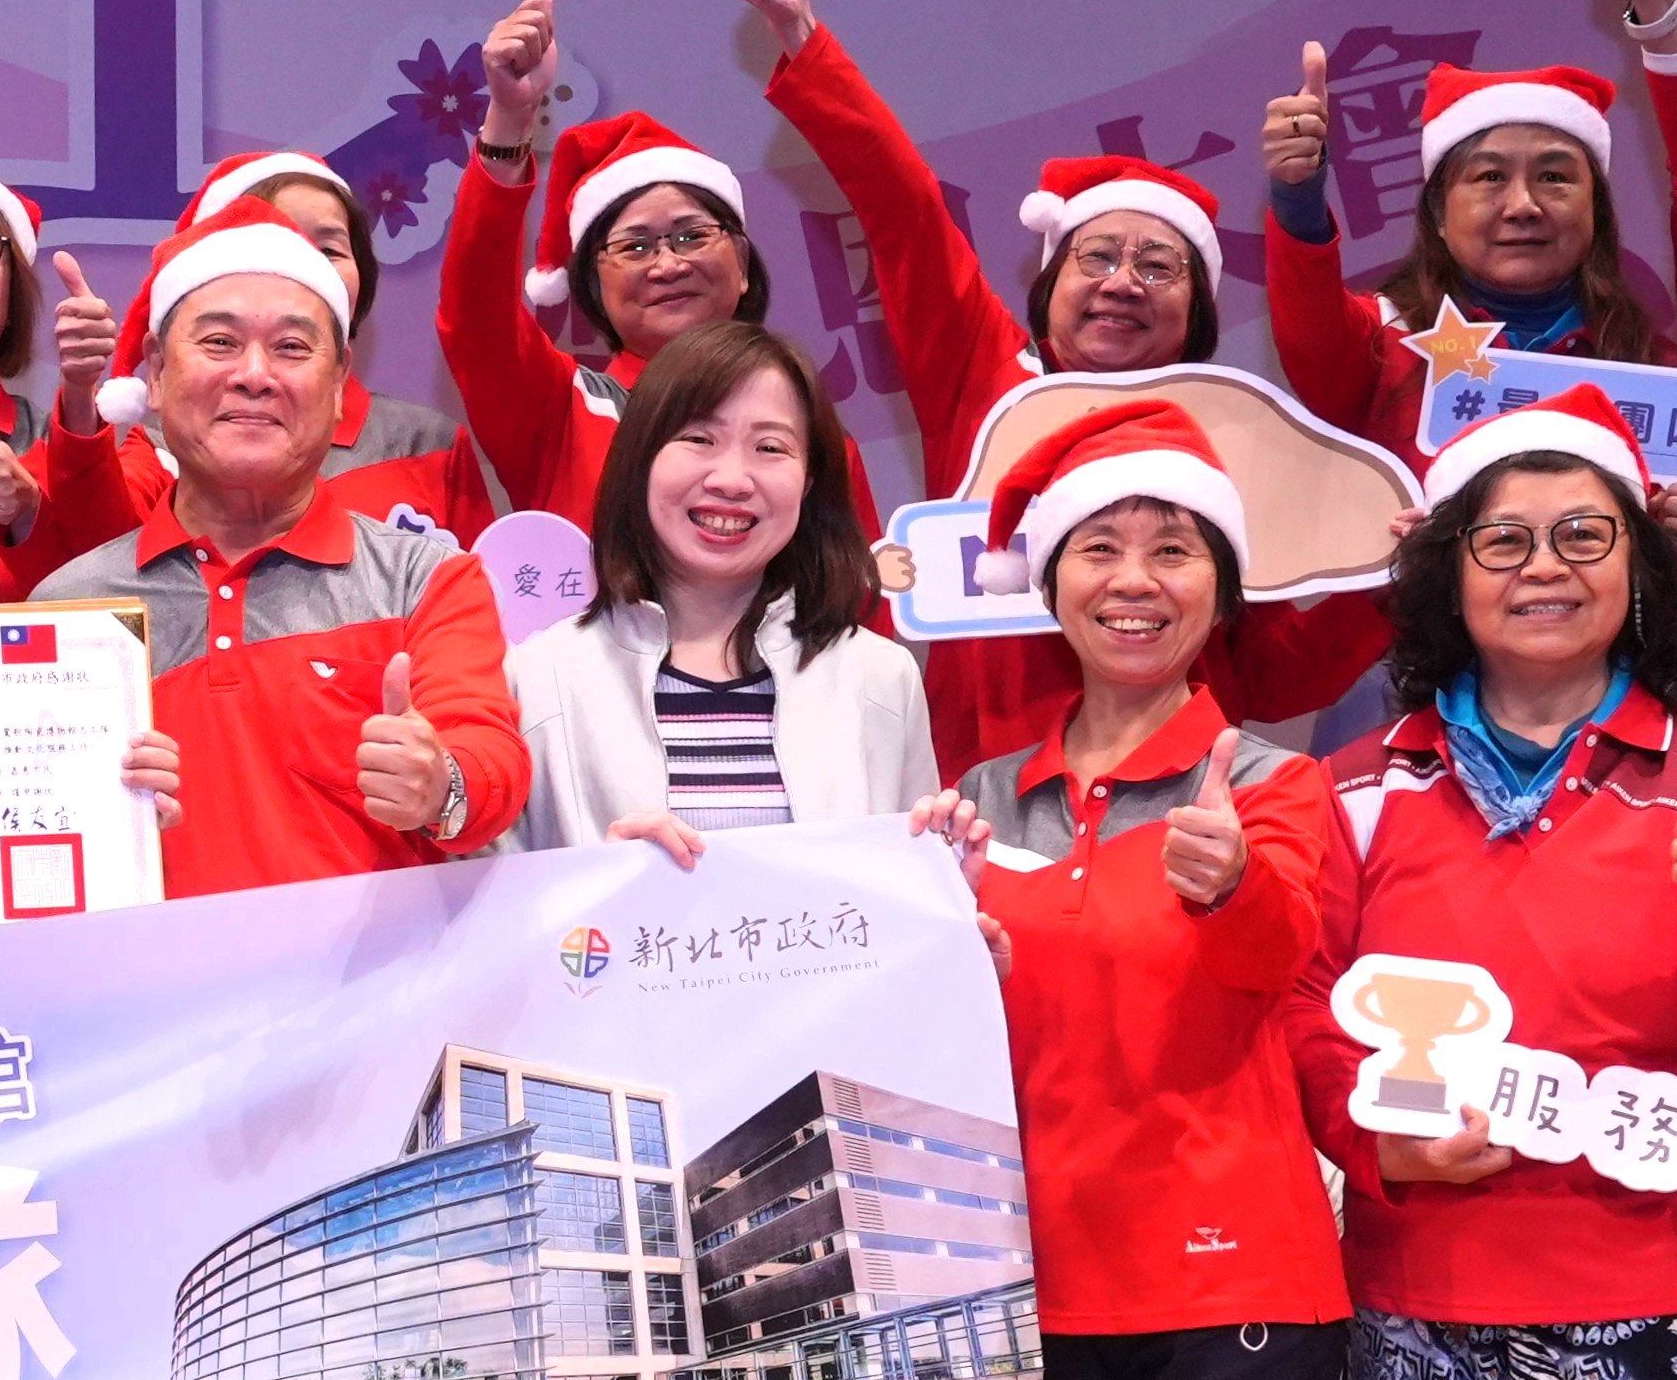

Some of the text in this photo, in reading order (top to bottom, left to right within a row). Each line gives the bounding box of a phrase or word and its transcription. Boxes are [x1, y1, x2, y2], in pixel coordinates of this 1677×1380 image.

[514, 563, 586, 599] 愛在
[628, 902, 870, 973] 新北市政府
[637, 958, 880, 994] New Taipei City Government
